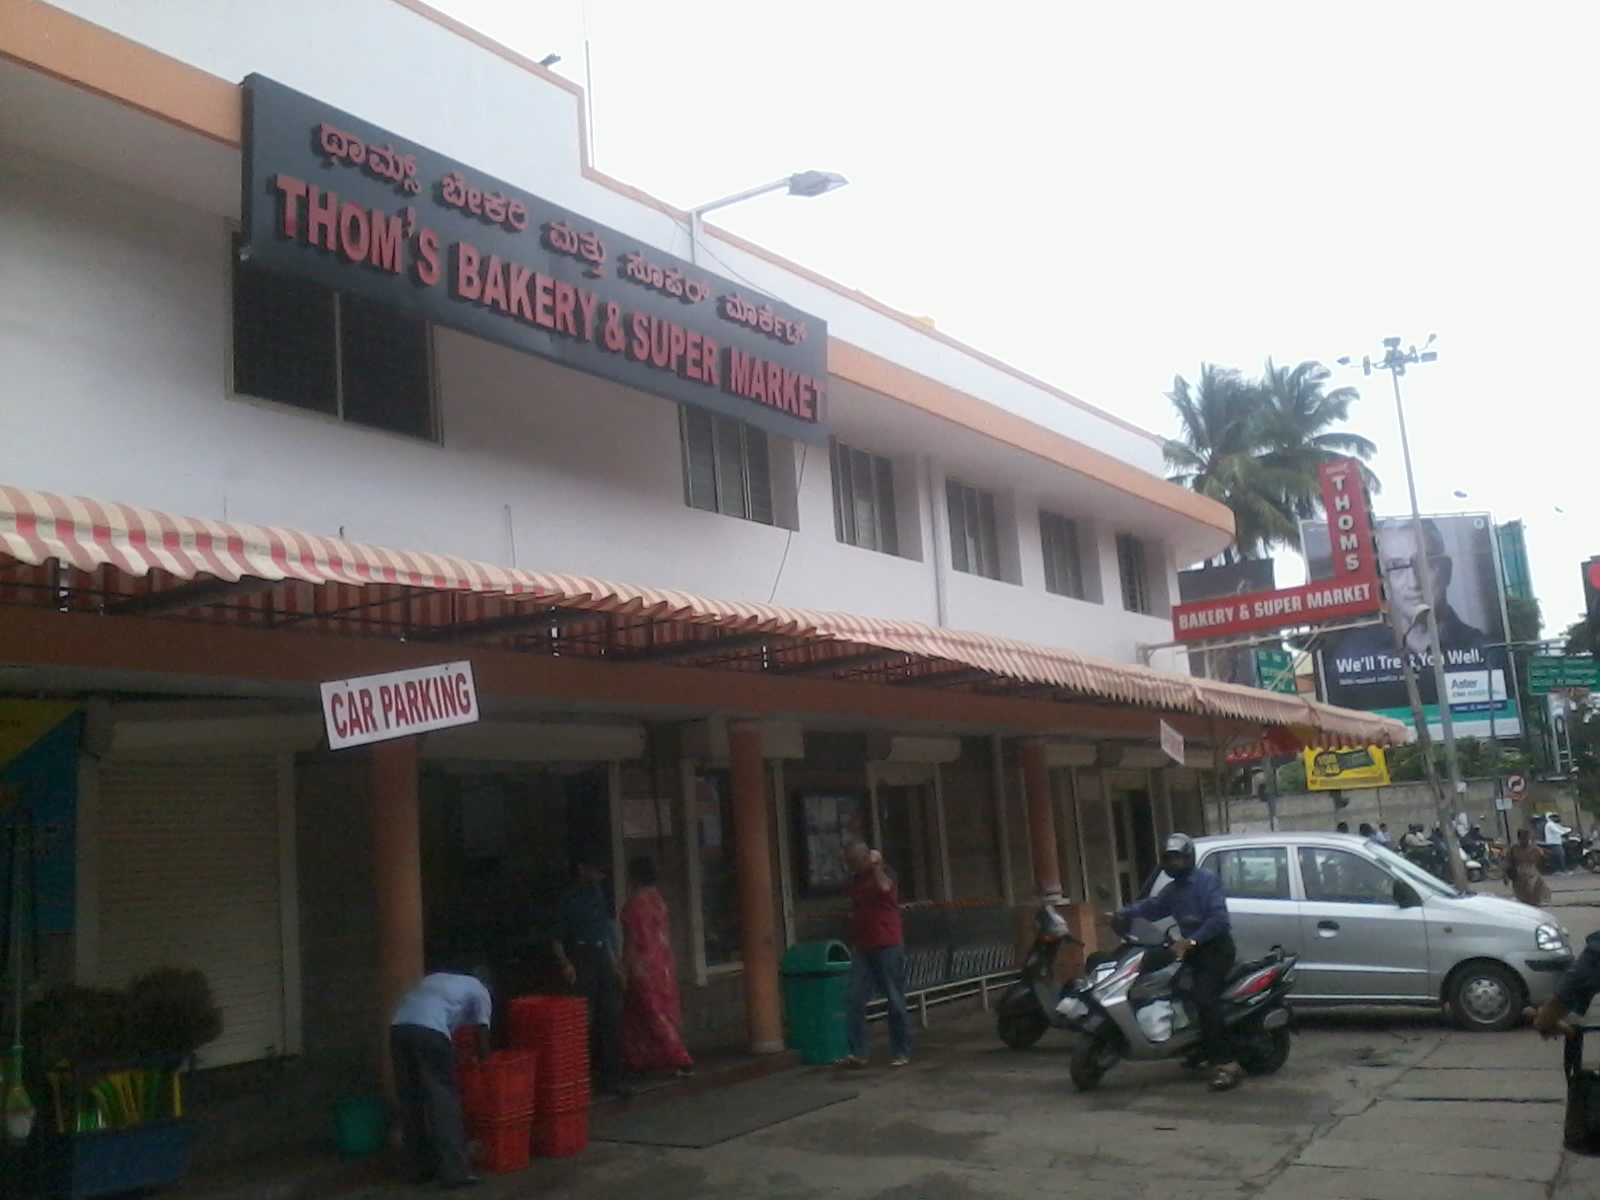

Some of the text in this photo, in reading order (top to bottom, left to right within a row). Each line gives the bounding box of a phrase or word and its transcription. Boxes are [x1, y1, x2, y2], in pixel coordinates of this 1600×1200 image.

[441, 171, 529, 230] ಬೇಕರಿ
[549, 219, 608, 278] ಮತ್ತು
[626, 251, 711, 304] ಸೂಪರ್
[724, 292, 808, 344] ಮಾರ್ಕೆಟ್
[274, 174, 827, 423] THOM'S BAKERY & SUPER MARKET
[1331, 474, 1360, 571] THOMS
[1178, 583, 1371, 631] BAKERY & SUPER MARKET
[1336, 655, 1375, 674] We'll
[1378, 653, 1416, 671] Tret
[1447, 648, 1485, 665] Well.
[1450, 678, 1479, 690] Aster
[331, 672, 472, 739] CAR PARKING
